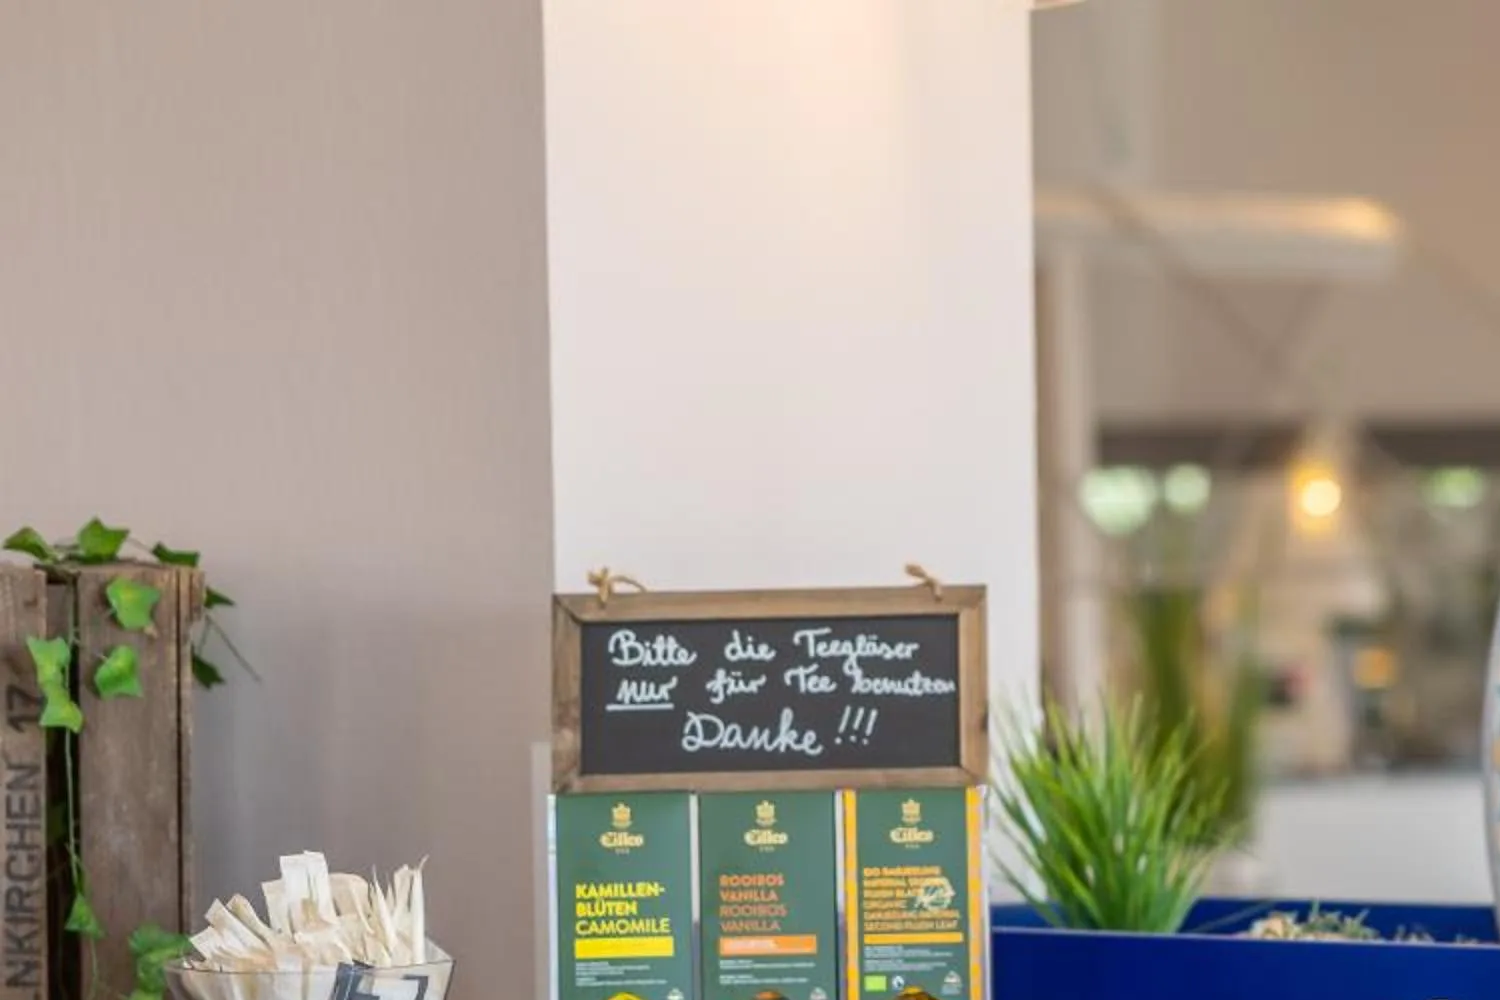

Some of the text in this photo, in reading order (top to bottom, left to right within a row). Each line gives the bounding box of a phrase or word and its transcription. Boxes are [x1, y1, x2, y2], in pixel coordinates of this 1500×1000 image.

[608, 627, 920, 674] Bitte die Teegläser
[616, 675, 678, 702] nur
[706, 669, 767, 704] für
[784, 667, 838, 693] Tee
[681, 707, 824, 756] Danke
[719, 874, 784, 887] ROOIBOS
[575, 882, 665, 899] KAMILLEN-
[719, 889, 778, 902] VANILLA
[575, 899, 638, 917] BLÜTEN
[575, 918, 671, 935] CAMOMILE
[719, 919, 781, 932] VANILLA
